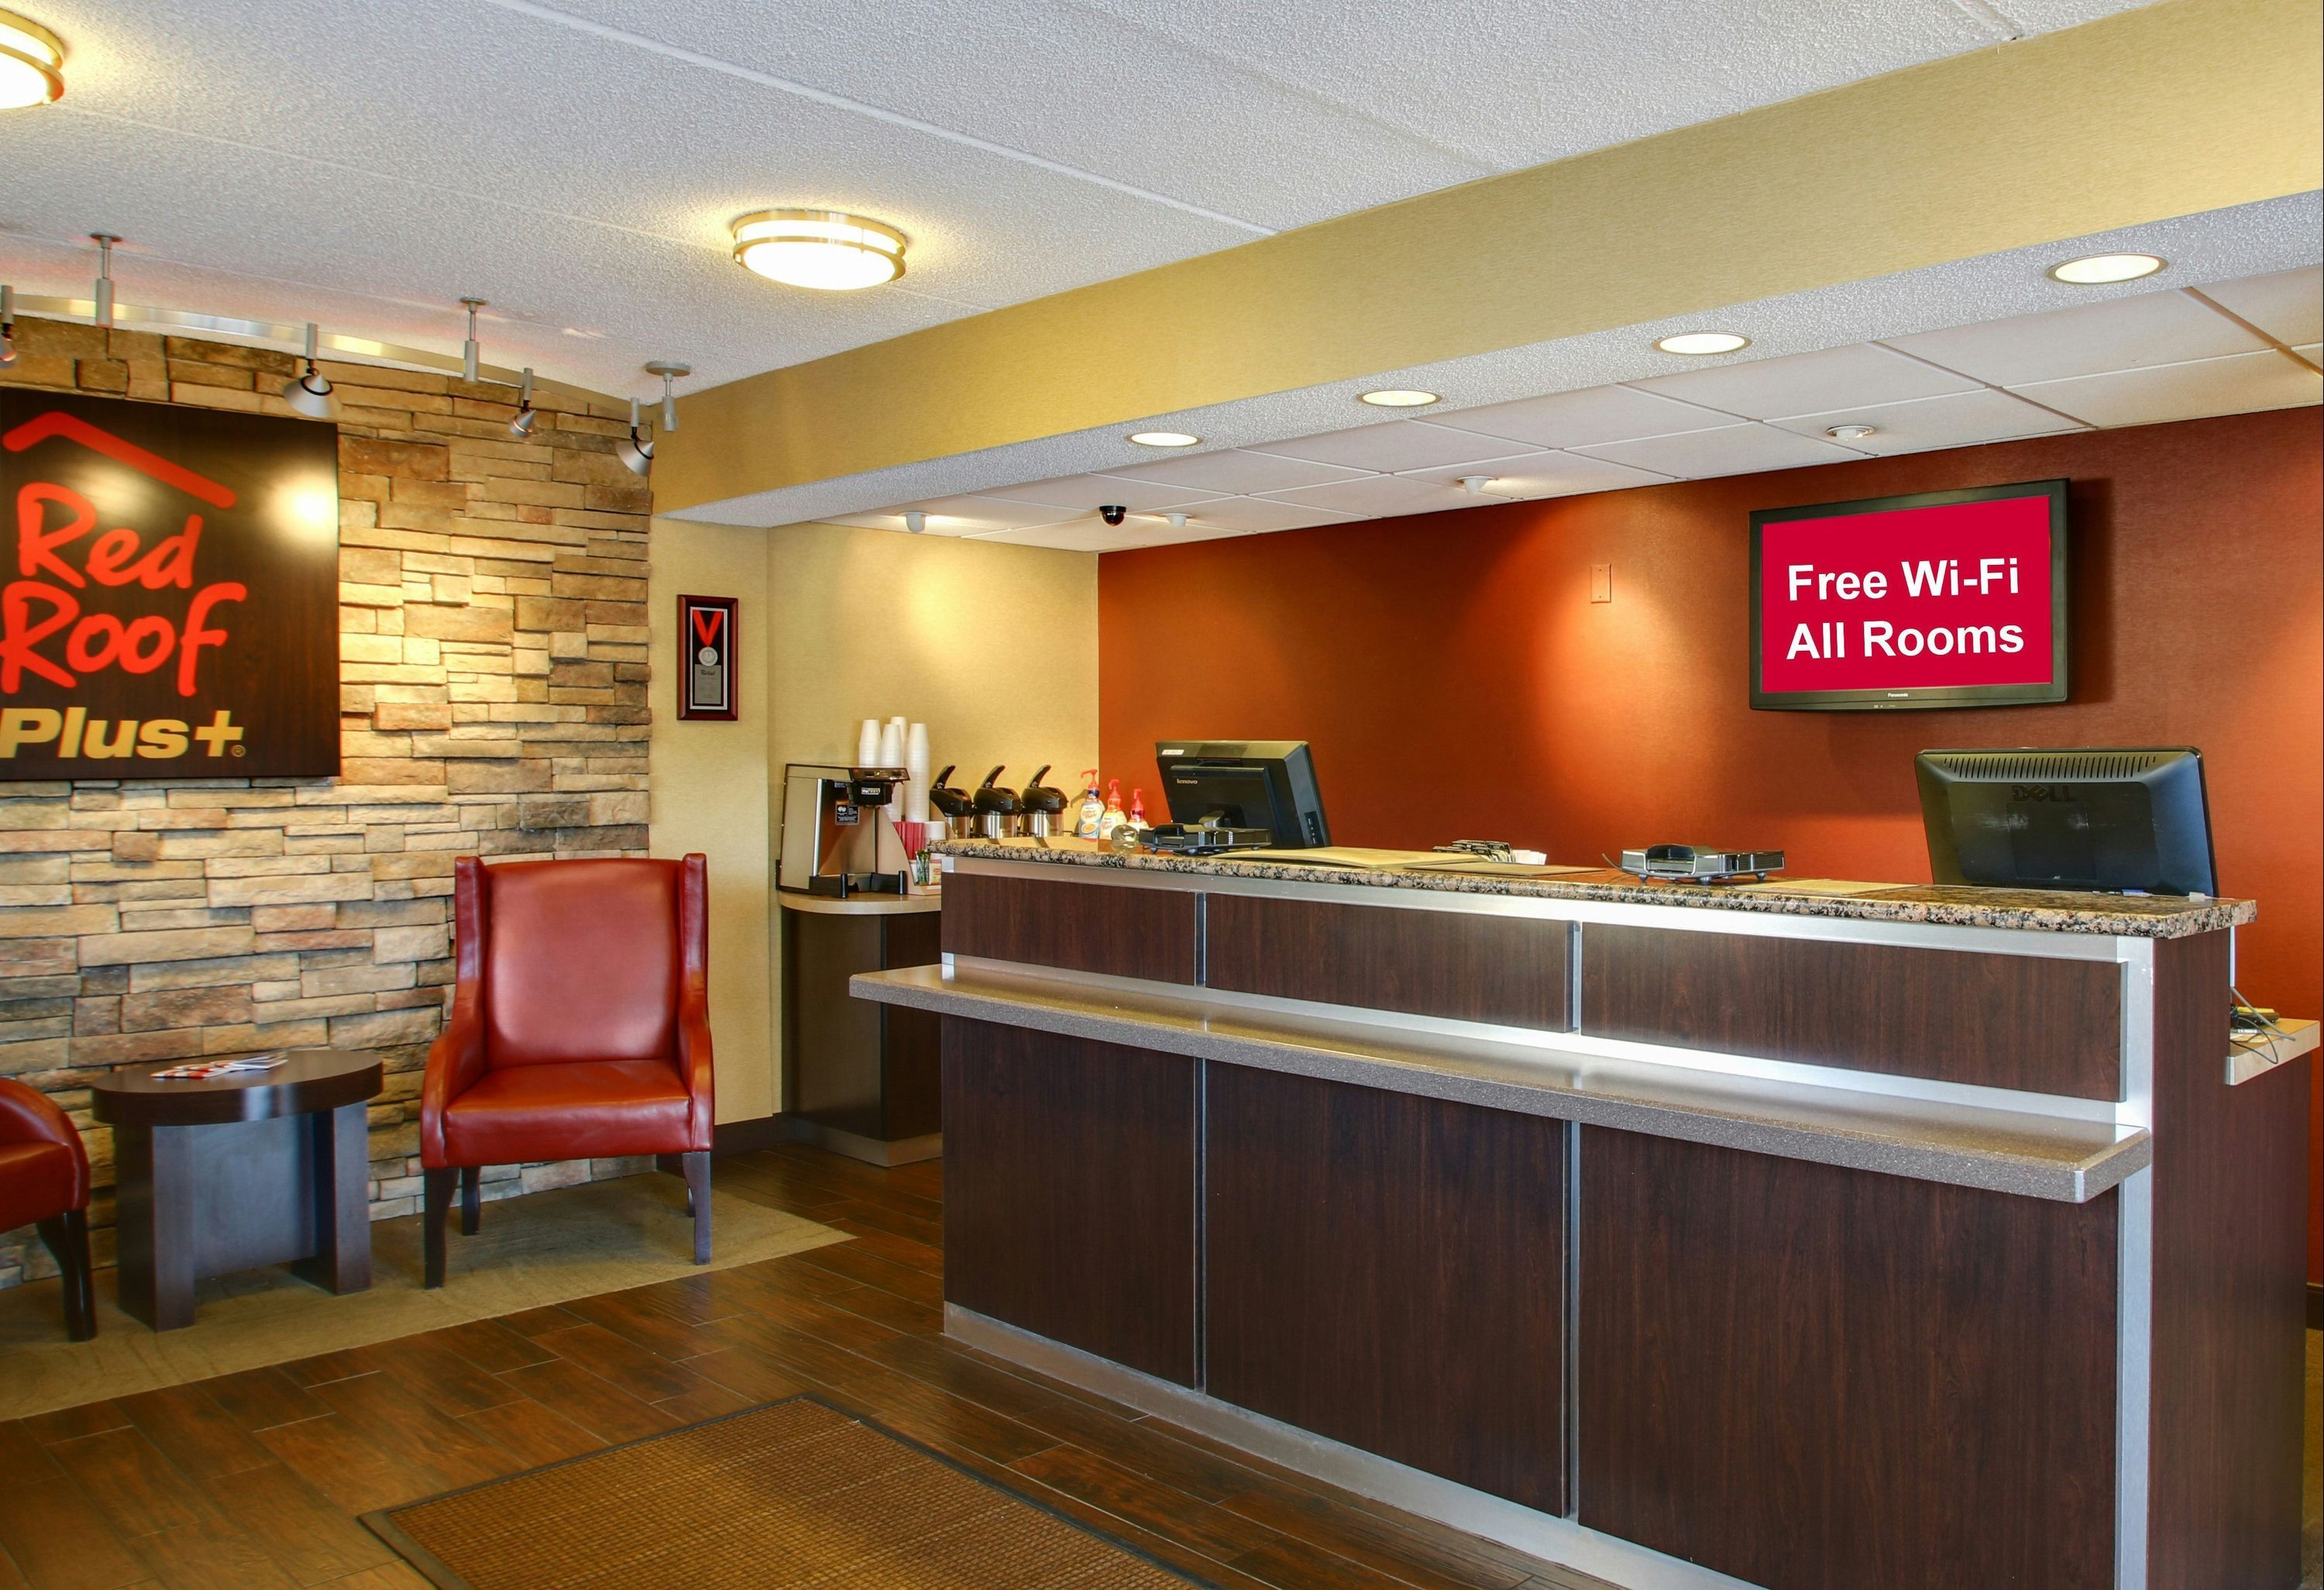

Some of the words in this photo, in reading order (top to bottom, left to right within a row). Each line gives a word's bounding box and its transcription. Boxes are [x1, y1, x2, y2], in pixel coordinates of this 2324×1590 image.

[17, 482, 204, 589] Red
[1788, 564, 1888, 601] Free
[1901, 557, 2019, 597] Wi-Fi
[0, 580, 247, 697] Roof
[1786, 621, 1846, 659] All
[1863, 620, 2024, 657] Rooms
[2011, 783, 2079, 802] DELL
